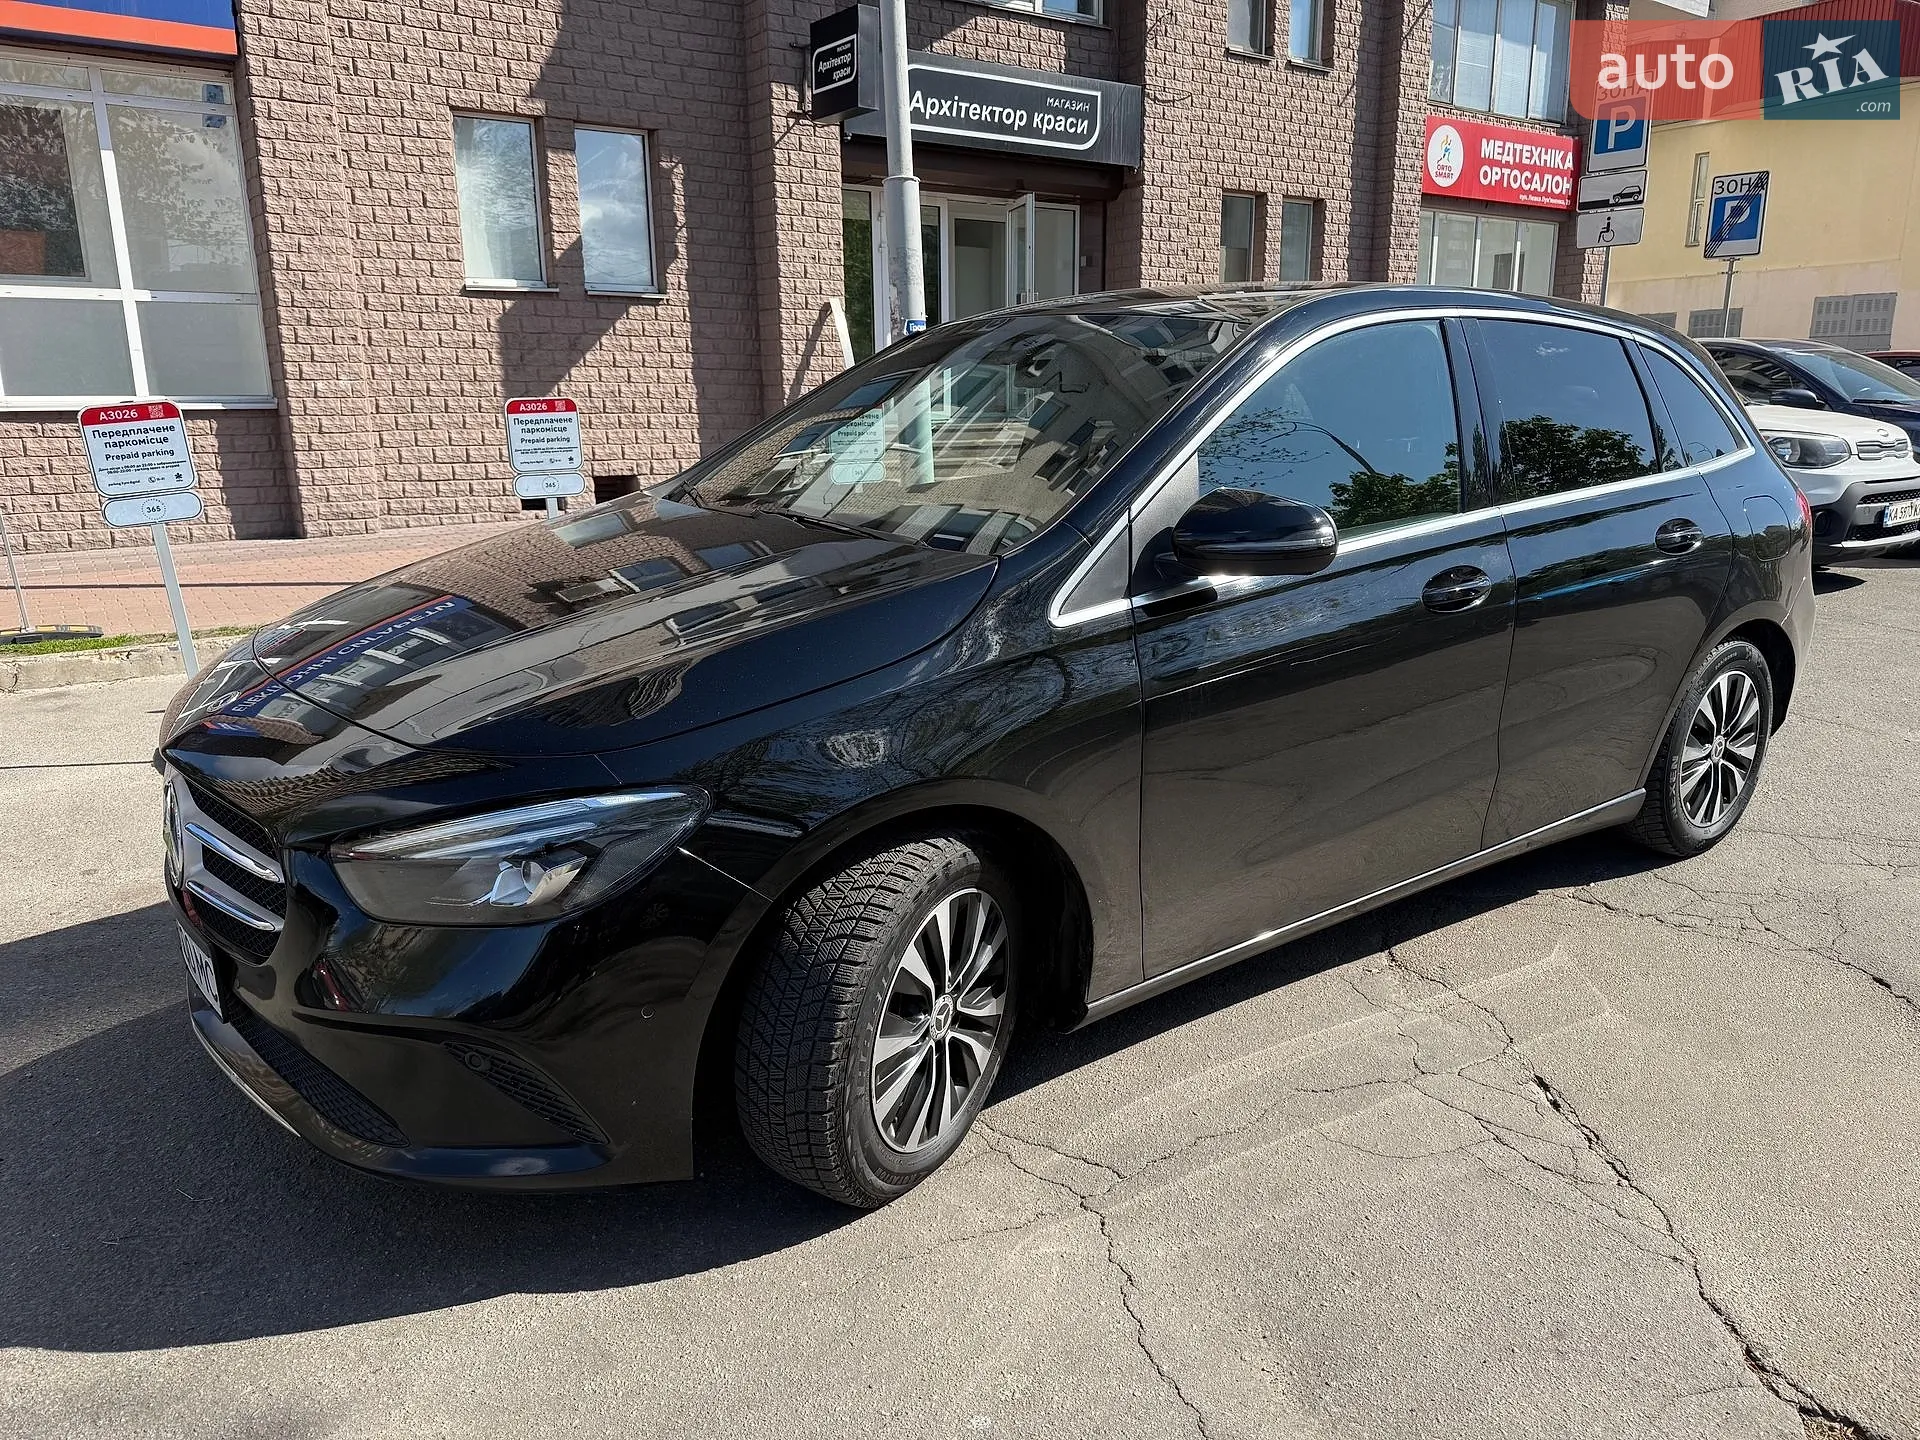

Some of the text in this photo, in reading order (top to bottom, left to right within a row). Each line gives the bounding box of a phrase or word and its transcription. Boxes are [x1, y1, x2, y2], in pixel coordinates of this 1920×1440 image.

[818, 53, 852, 73] Архітектор
[833, 66, 851, 81] краси
[1046, 97, 1091, 112] МАГАЗИН
[910, 91, 1089, 135] Архітектор краси
[1480, 138, 1574, 170] МЕДТЕХНІКА
[1434, 171, 1454, 180] SMART
[1436, 164, 1453, 173] ORTO
[1479, 165, 1573, 196] ОРТОСАЛОН
[519, 402, 548, 411] A3026
[99, 408, 139, 421] A3026
[513, 417, 573, 426] Передплачене
[91, 424, 176, 440] Передплачене
[521, 425, 568, 435] паркомісце
[104, 435, 169, 449] паркомісце
[520, 436, 571, 445] Prepaid parking
[105, 448, 175, 462] Prepaid parking
[146, 505, 162, 514] 365
